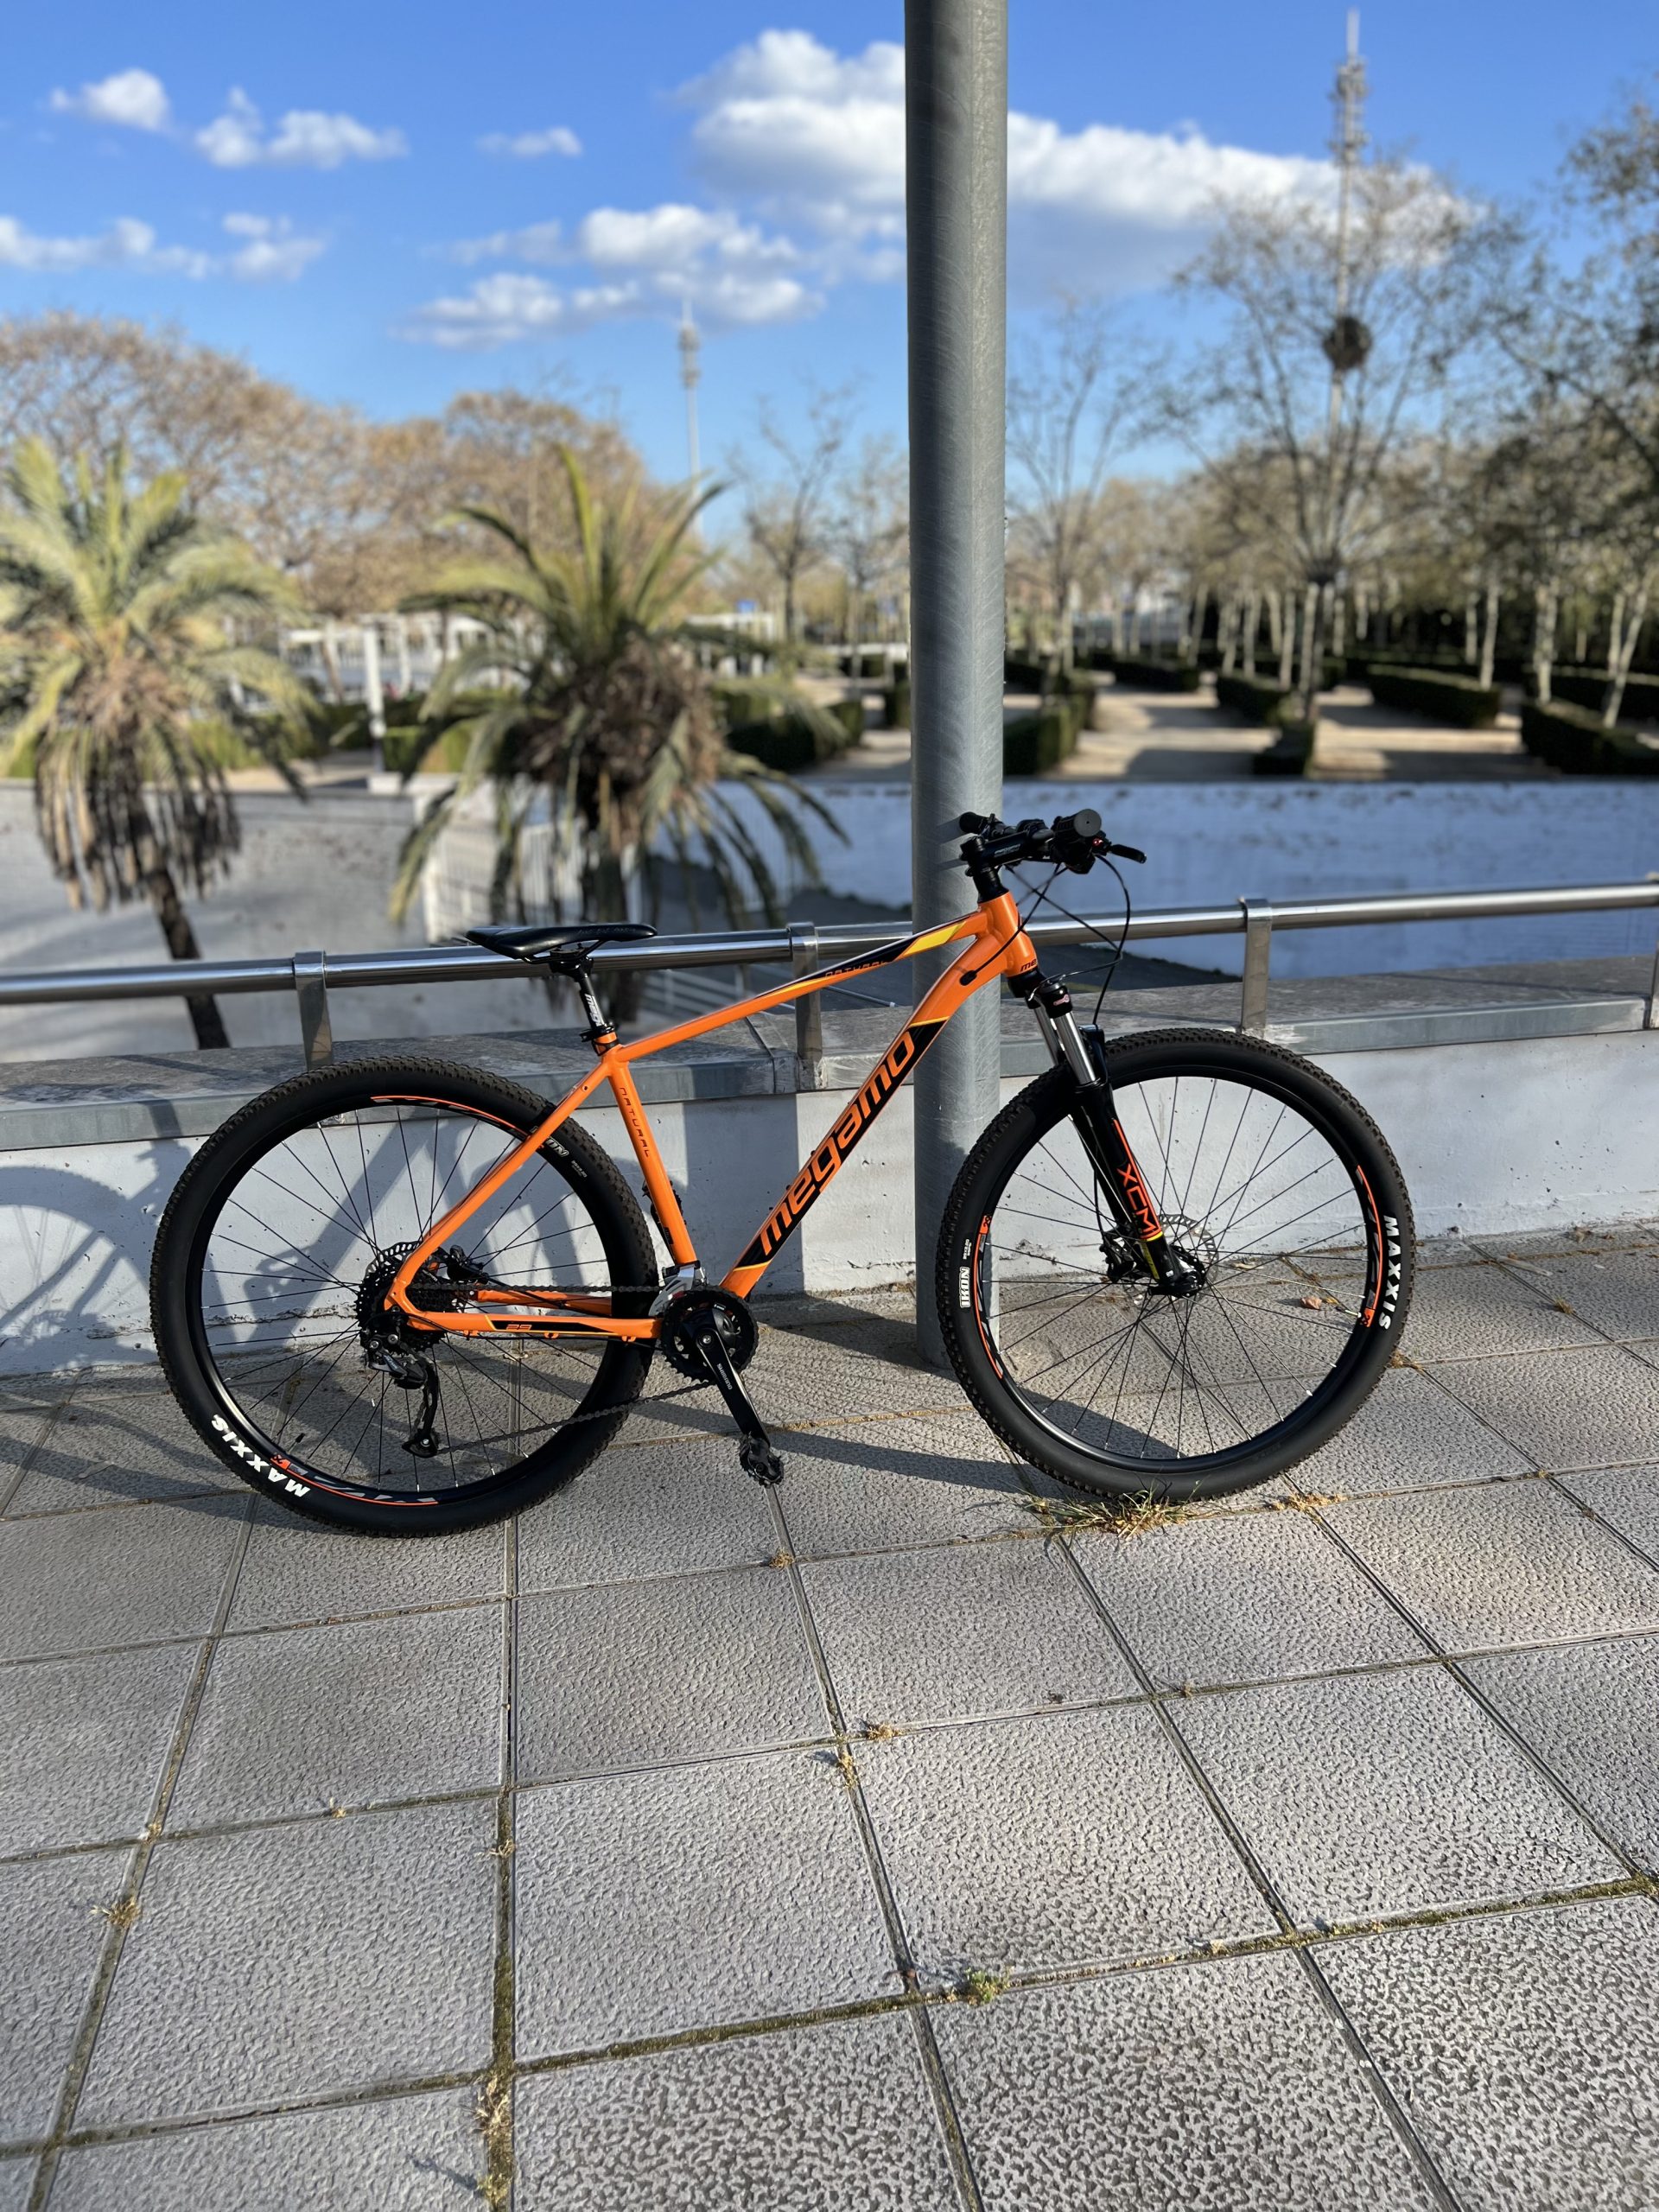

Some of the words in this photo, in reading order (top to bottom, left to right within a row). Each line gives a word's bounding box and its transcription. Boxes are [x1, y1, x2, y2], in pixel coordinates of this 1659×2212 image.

[620, 1087, 649, 1158] NATURAL
[760, 1031, 915, 1256] megamo
[1116, 1163, 1158, 1233] XCM
[959, 1267, 971, 1308] IKON
[1378, 1214, 1402, 1330] MAXXIS
[211, 1414, 311, 1497] MAXXIS
